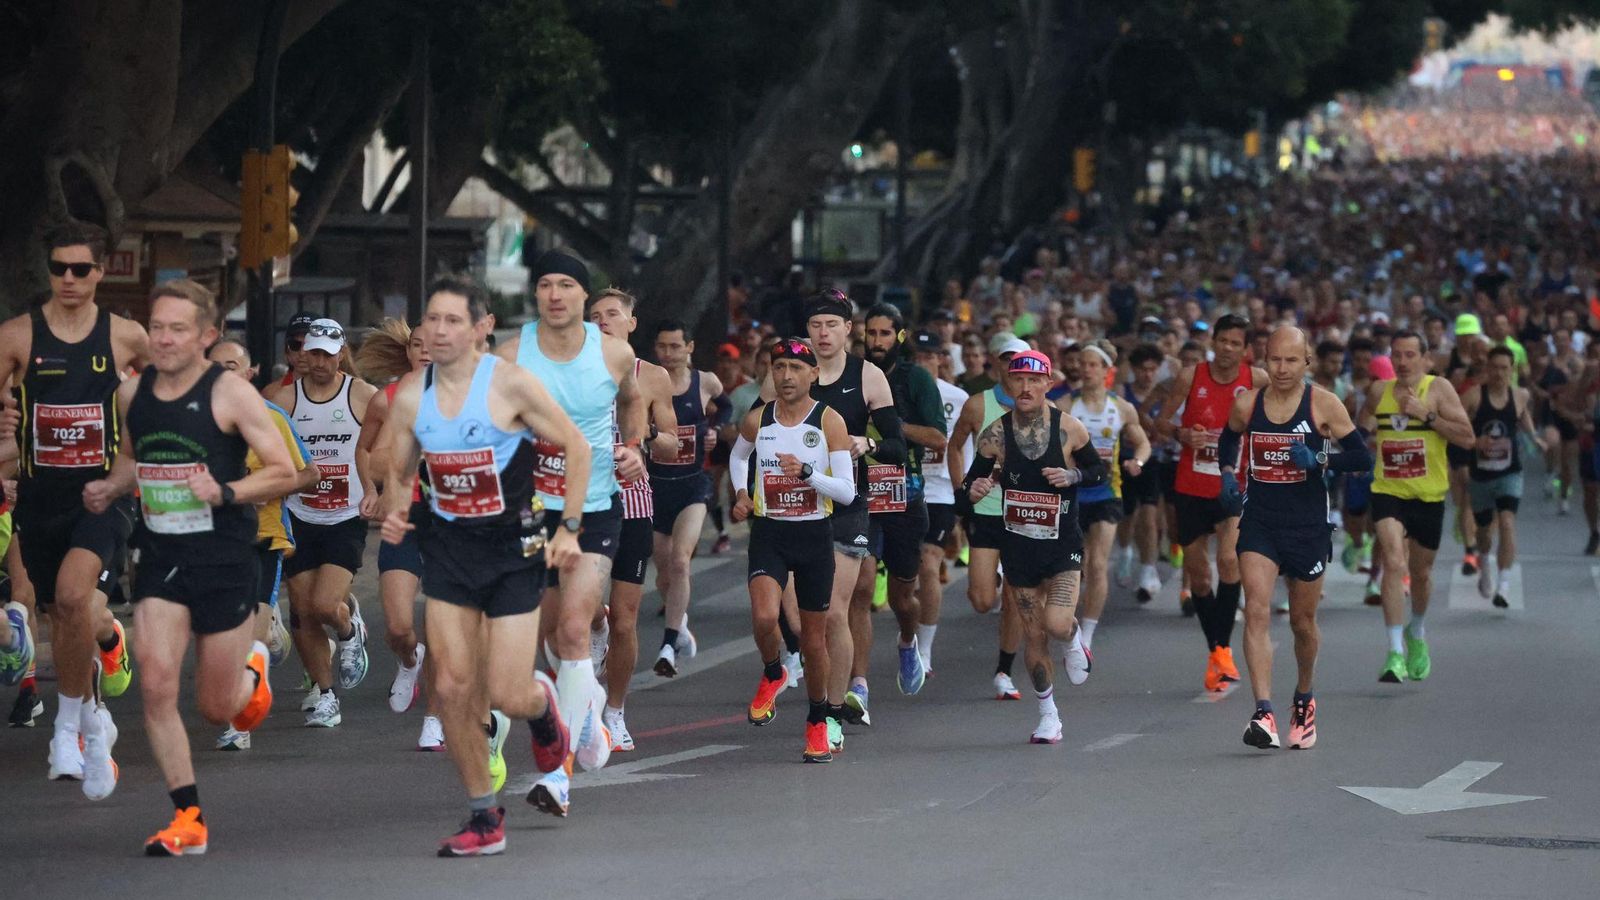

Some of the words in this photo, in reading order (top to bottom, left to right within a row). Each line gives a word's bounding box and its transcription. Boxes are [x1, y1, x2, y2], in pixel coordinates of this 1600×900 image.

[51, 408, 98, 418] GENERALI
[52, 428, 86, 440] 7022
[438, 452, 488, 464] GENERALI
[1264, 451, 1290, 461] 6256
[442, 474, 477, 488] 3921
[777, 477, 806, 485] GENER
[151, 489, 192, 502] 18035
[778, 492, 804, 503] 1054
[1020, 494, 1056, 504] GENERALI
[1016, 508, 1047, 520] 10449
